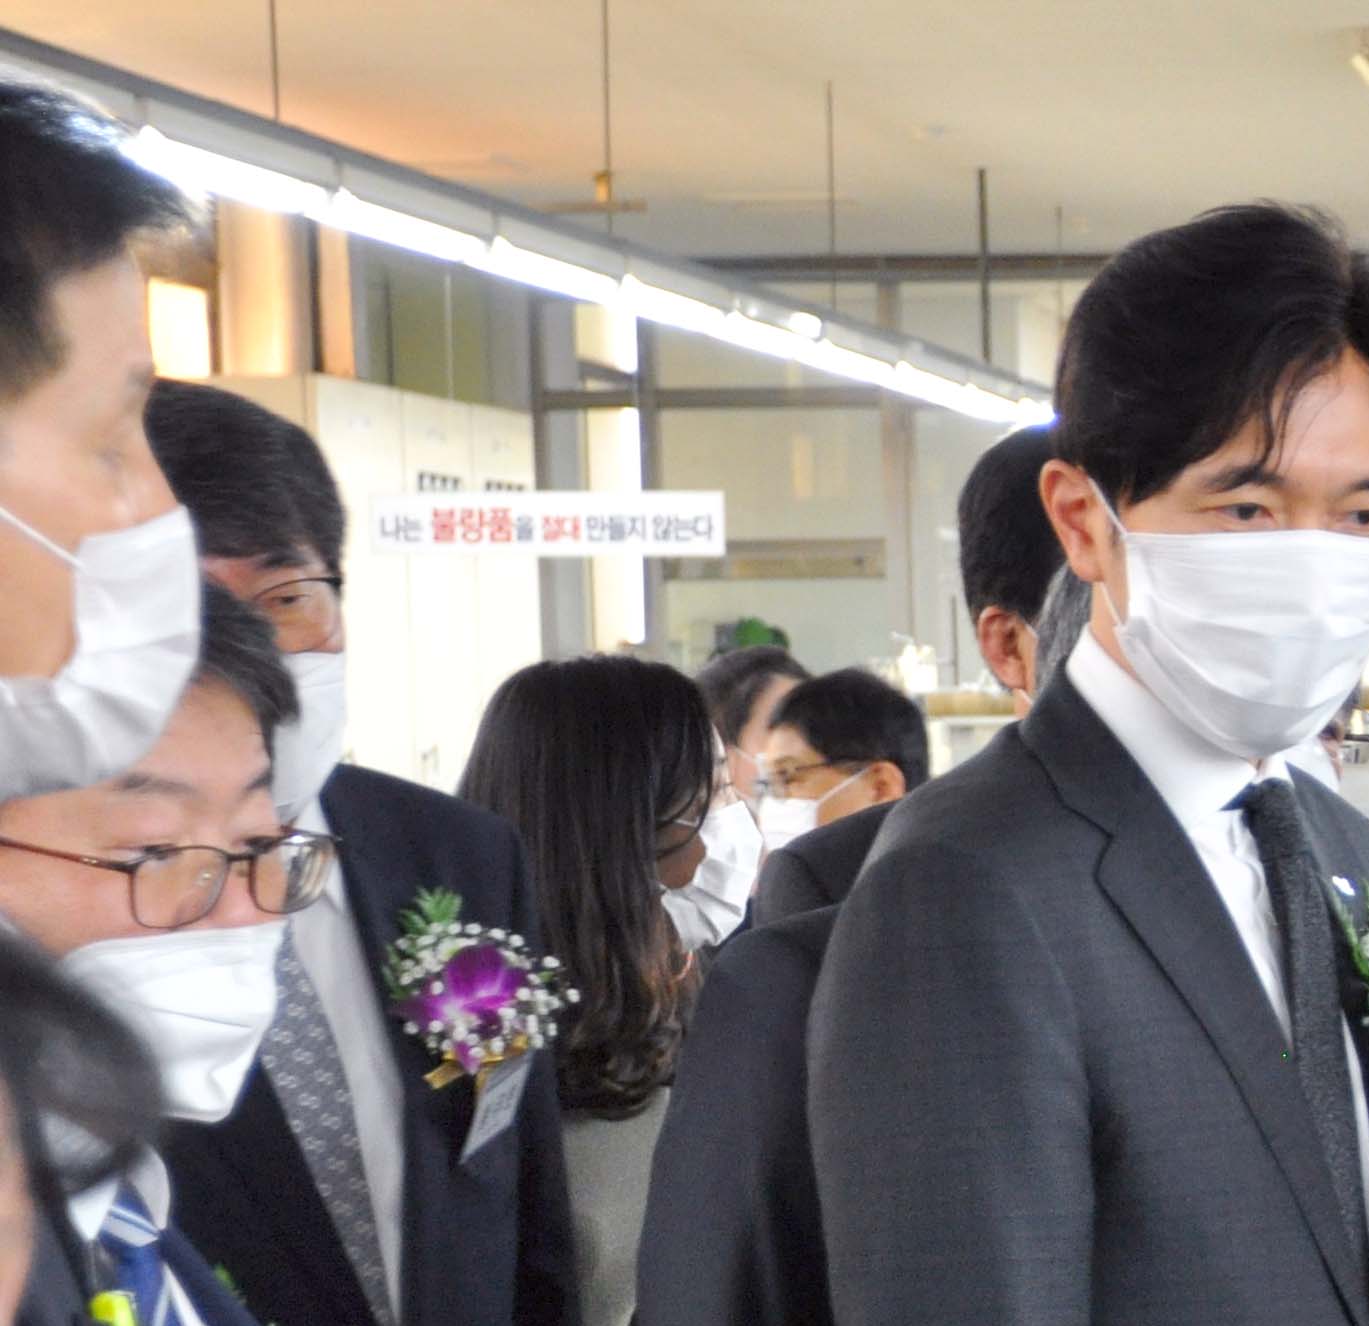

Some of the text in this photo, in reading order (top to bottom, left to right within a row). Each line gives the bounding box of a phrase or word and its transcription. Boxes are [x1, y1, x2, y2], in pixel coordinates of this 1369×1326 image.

[379, 507, 714, 544] 나는 불량품을 절대 만들지 않는다
